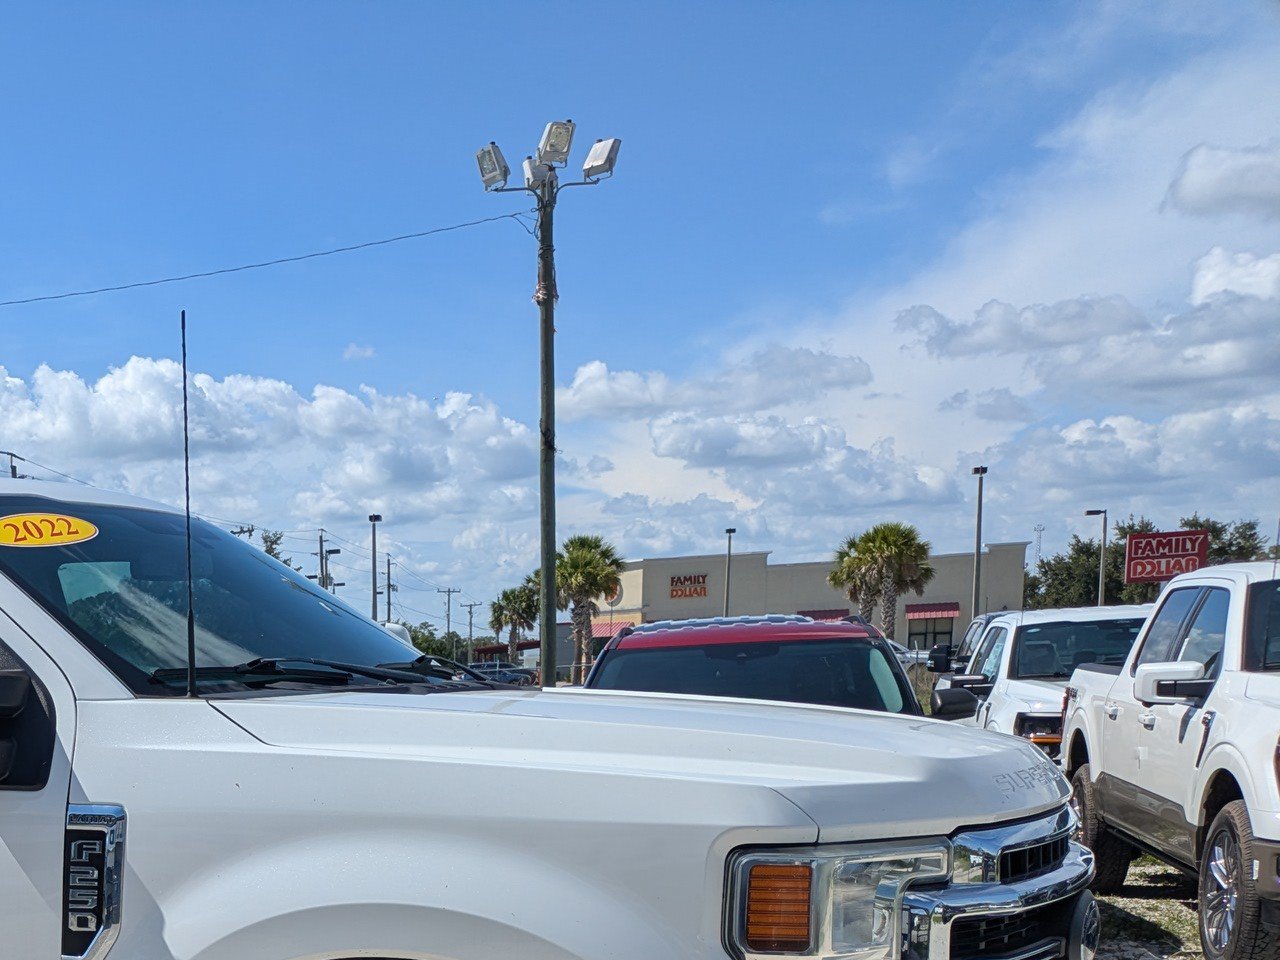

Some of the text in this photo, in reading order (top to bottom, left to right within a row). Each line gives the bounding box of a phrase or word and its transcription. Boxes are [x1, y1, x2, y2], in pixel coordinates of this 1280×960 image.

[3, 517, 79, 543] 2022
[1131, 534, 1205, 557] FAMILY
[1130, 556, 1199, 578] DOLLAR
[670, 574, 708, 587] FAMILY
[670, 586, 707, 599] DOLLAR
